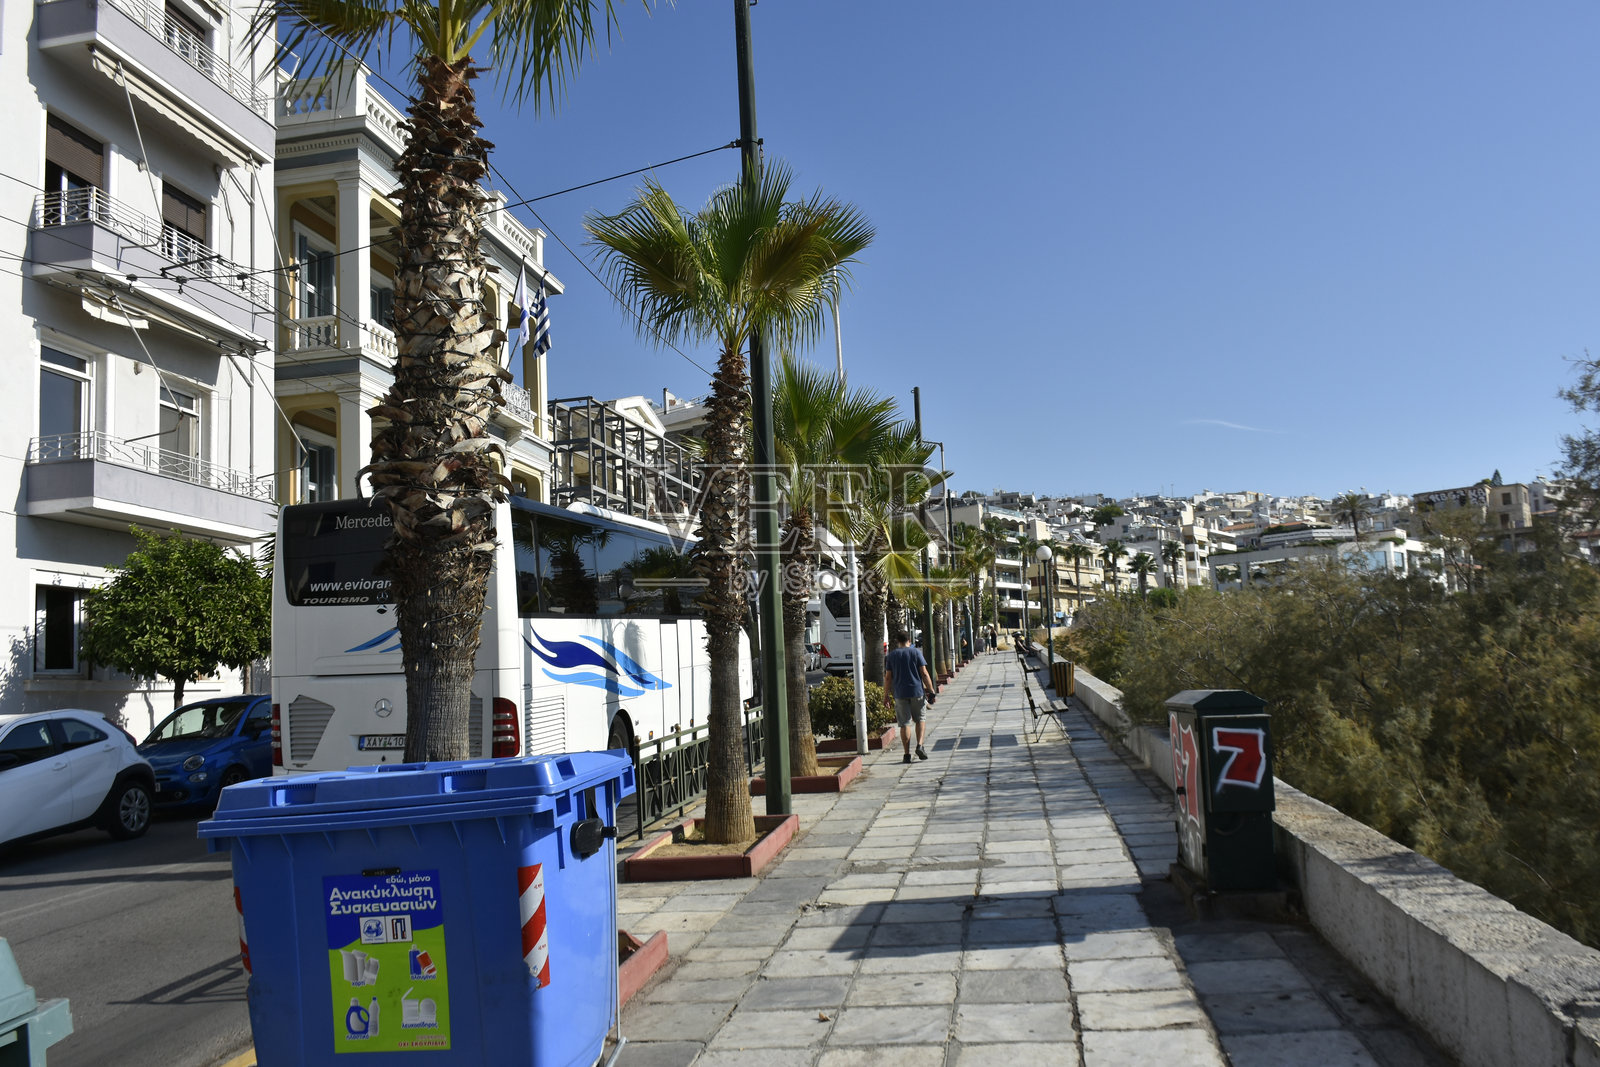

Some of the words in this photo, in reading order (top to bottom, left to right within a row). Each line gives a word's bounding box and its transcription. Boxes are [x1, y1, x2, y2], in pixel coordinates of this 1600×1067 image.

[335, 513, 393, 530] Mercede
[302, 596, 370, 605] TOURISMO
[409, 874, 430, 884] μόνο
[329, 884, 434, 901] Ανακύκλωση
[329, 896, 437, 915] Συσκευασιών
